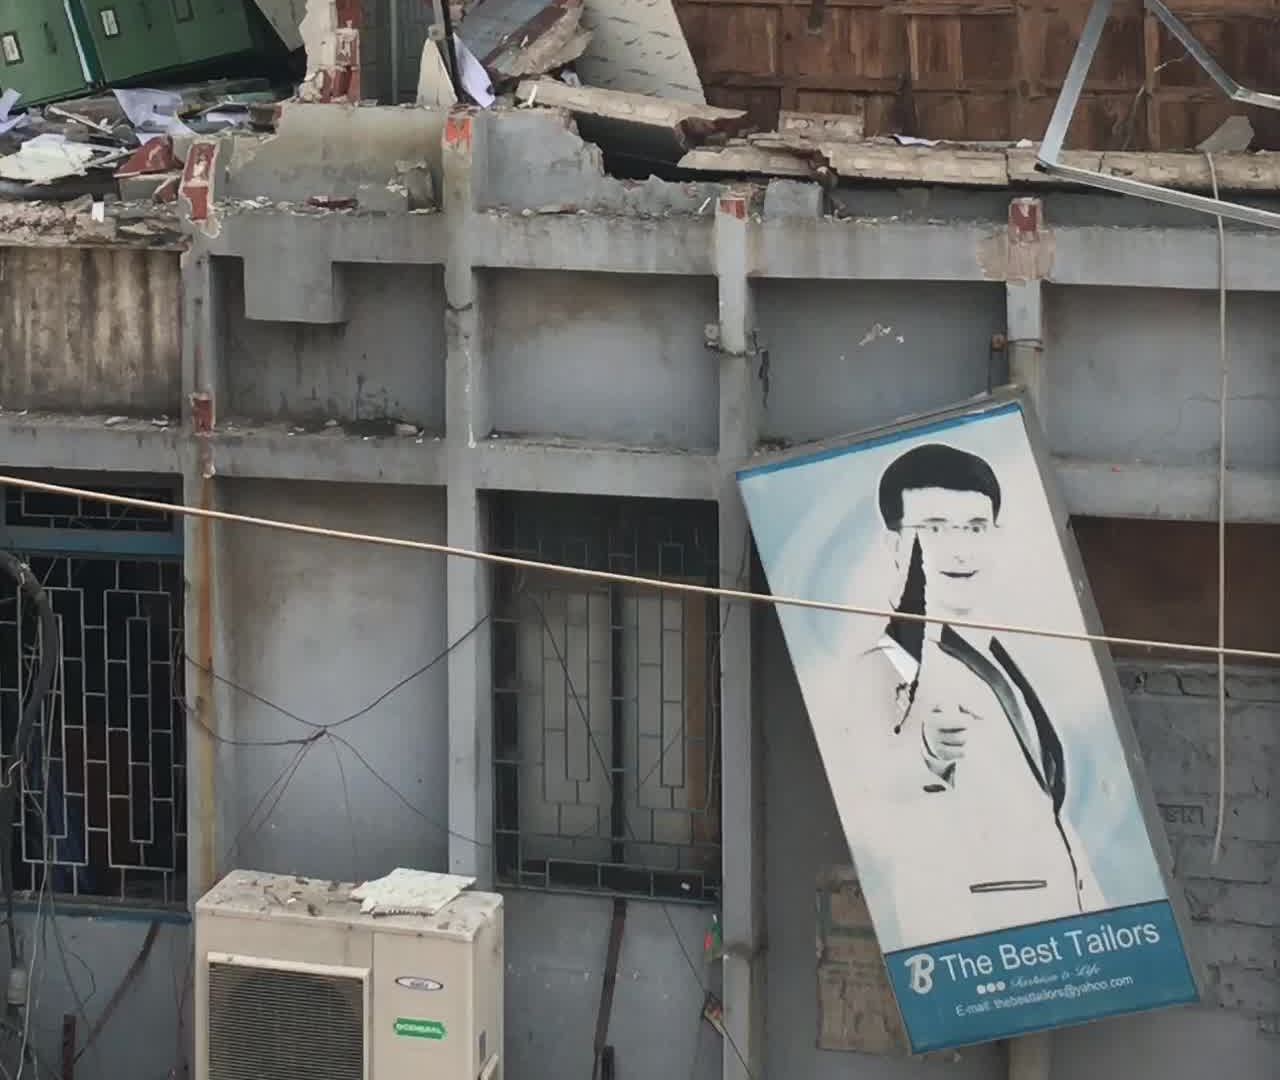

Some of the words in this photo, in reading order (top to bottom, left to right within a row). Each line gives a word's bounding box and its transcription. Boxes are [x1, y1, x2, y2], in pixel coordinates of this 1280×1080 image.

[939, 952, 994, 982] The
[999, 936, 1063, 971] Best
[1064, 921, 1161, 957] Tailors
